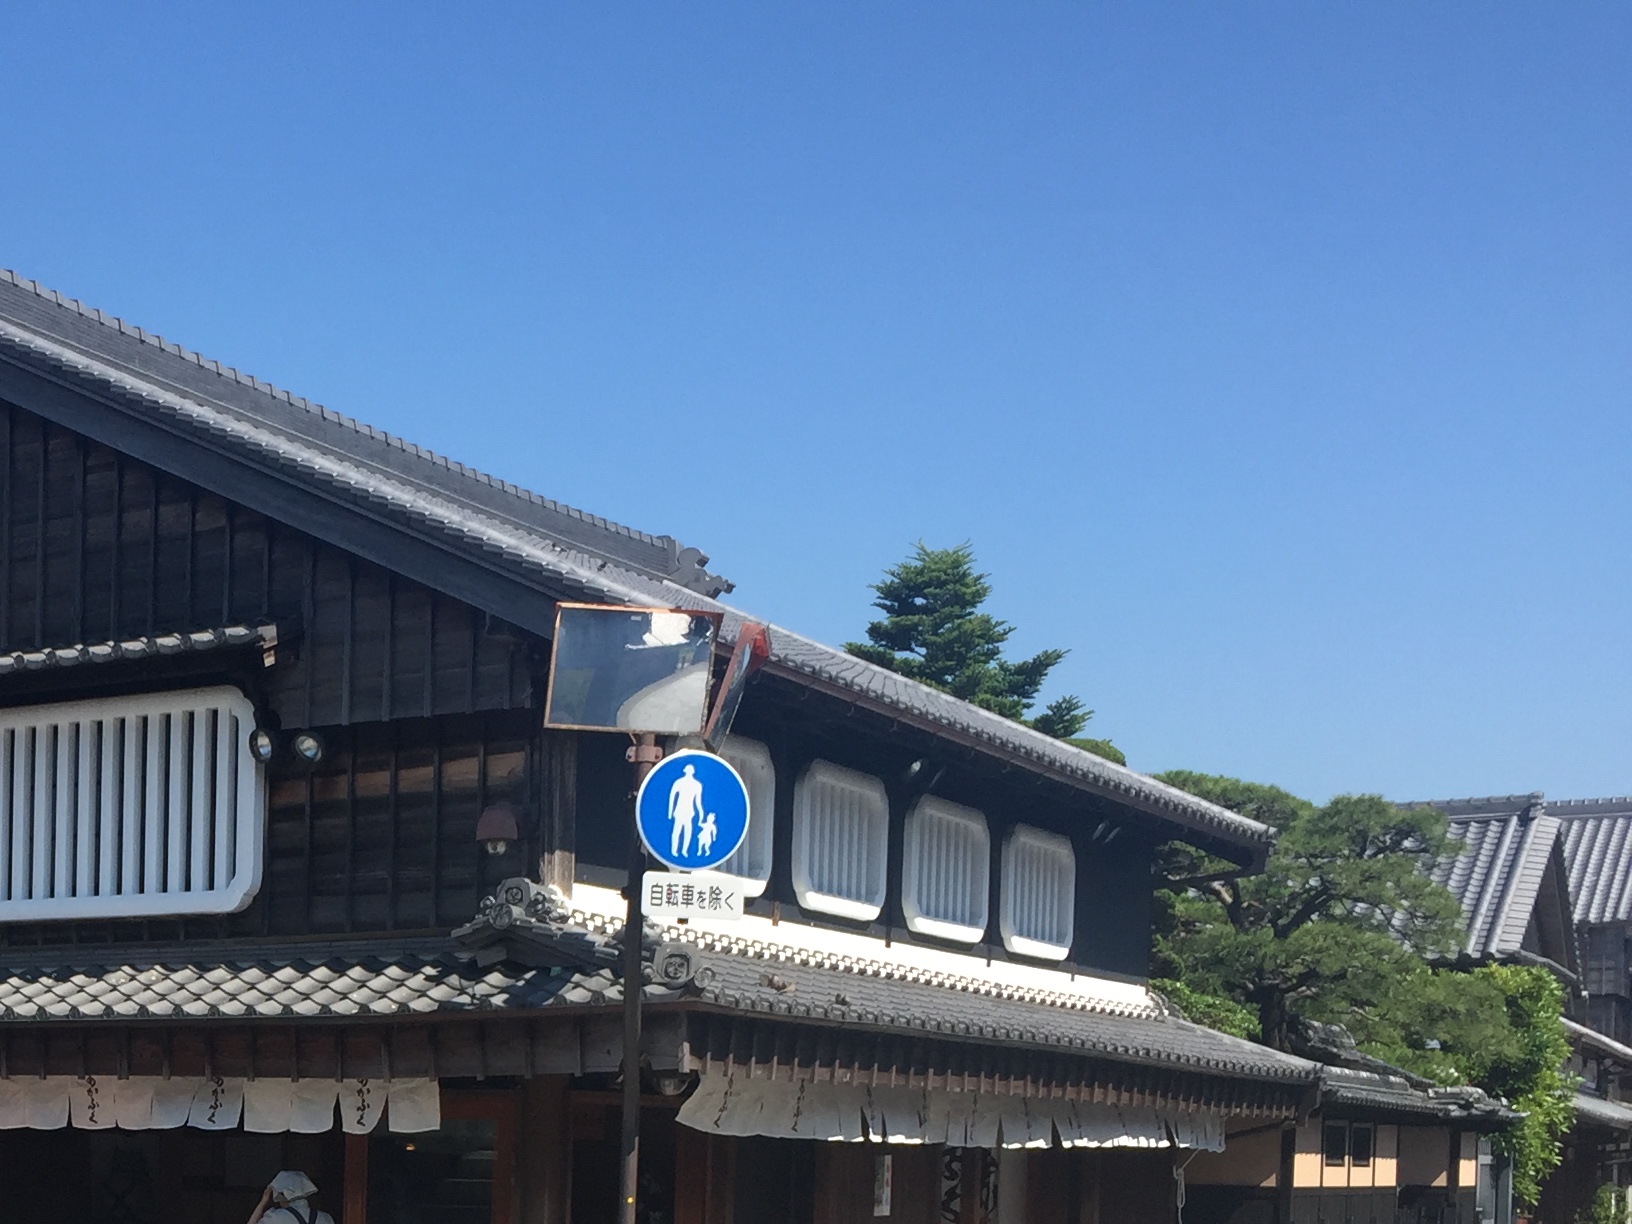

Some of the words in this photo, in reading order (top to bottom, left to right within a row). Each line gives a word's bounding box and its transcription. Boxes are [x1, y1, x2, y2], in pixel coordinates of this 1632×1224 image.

[650, 882, 735, 911] 自転車を除く
